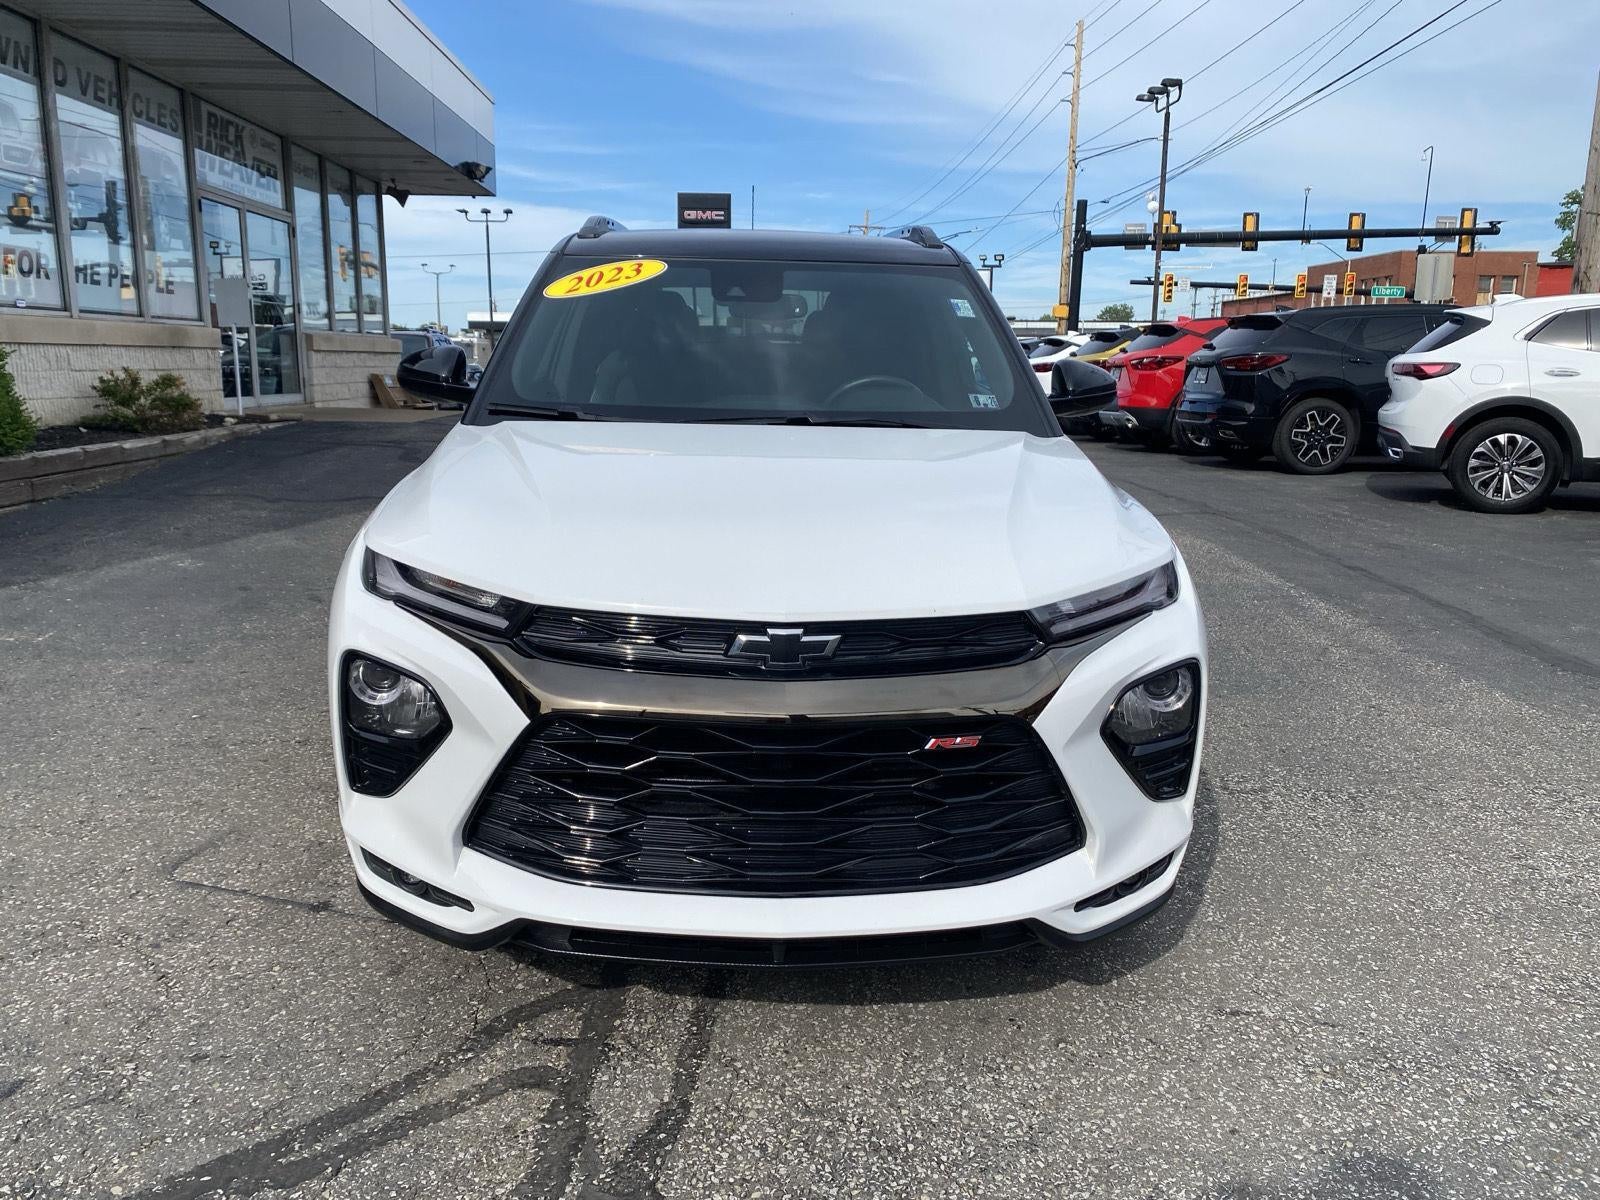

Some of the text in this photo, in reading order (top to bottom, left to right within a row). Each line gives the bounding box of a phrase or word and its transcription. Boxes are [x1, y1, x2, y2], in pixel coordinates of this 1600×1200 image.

[76, 66, 180, 133] VEHCLES
[206, 110, 247, 161] RICK
[684, 210, 725, 220] GMC
[3, 248, 50, 281] FOR
[74, 262, 101, 287] HE
[563, 262, 644, 294] 2023
[1375, 287, 1402, 297] Liberty
[924, 736, 982, 750] RS
